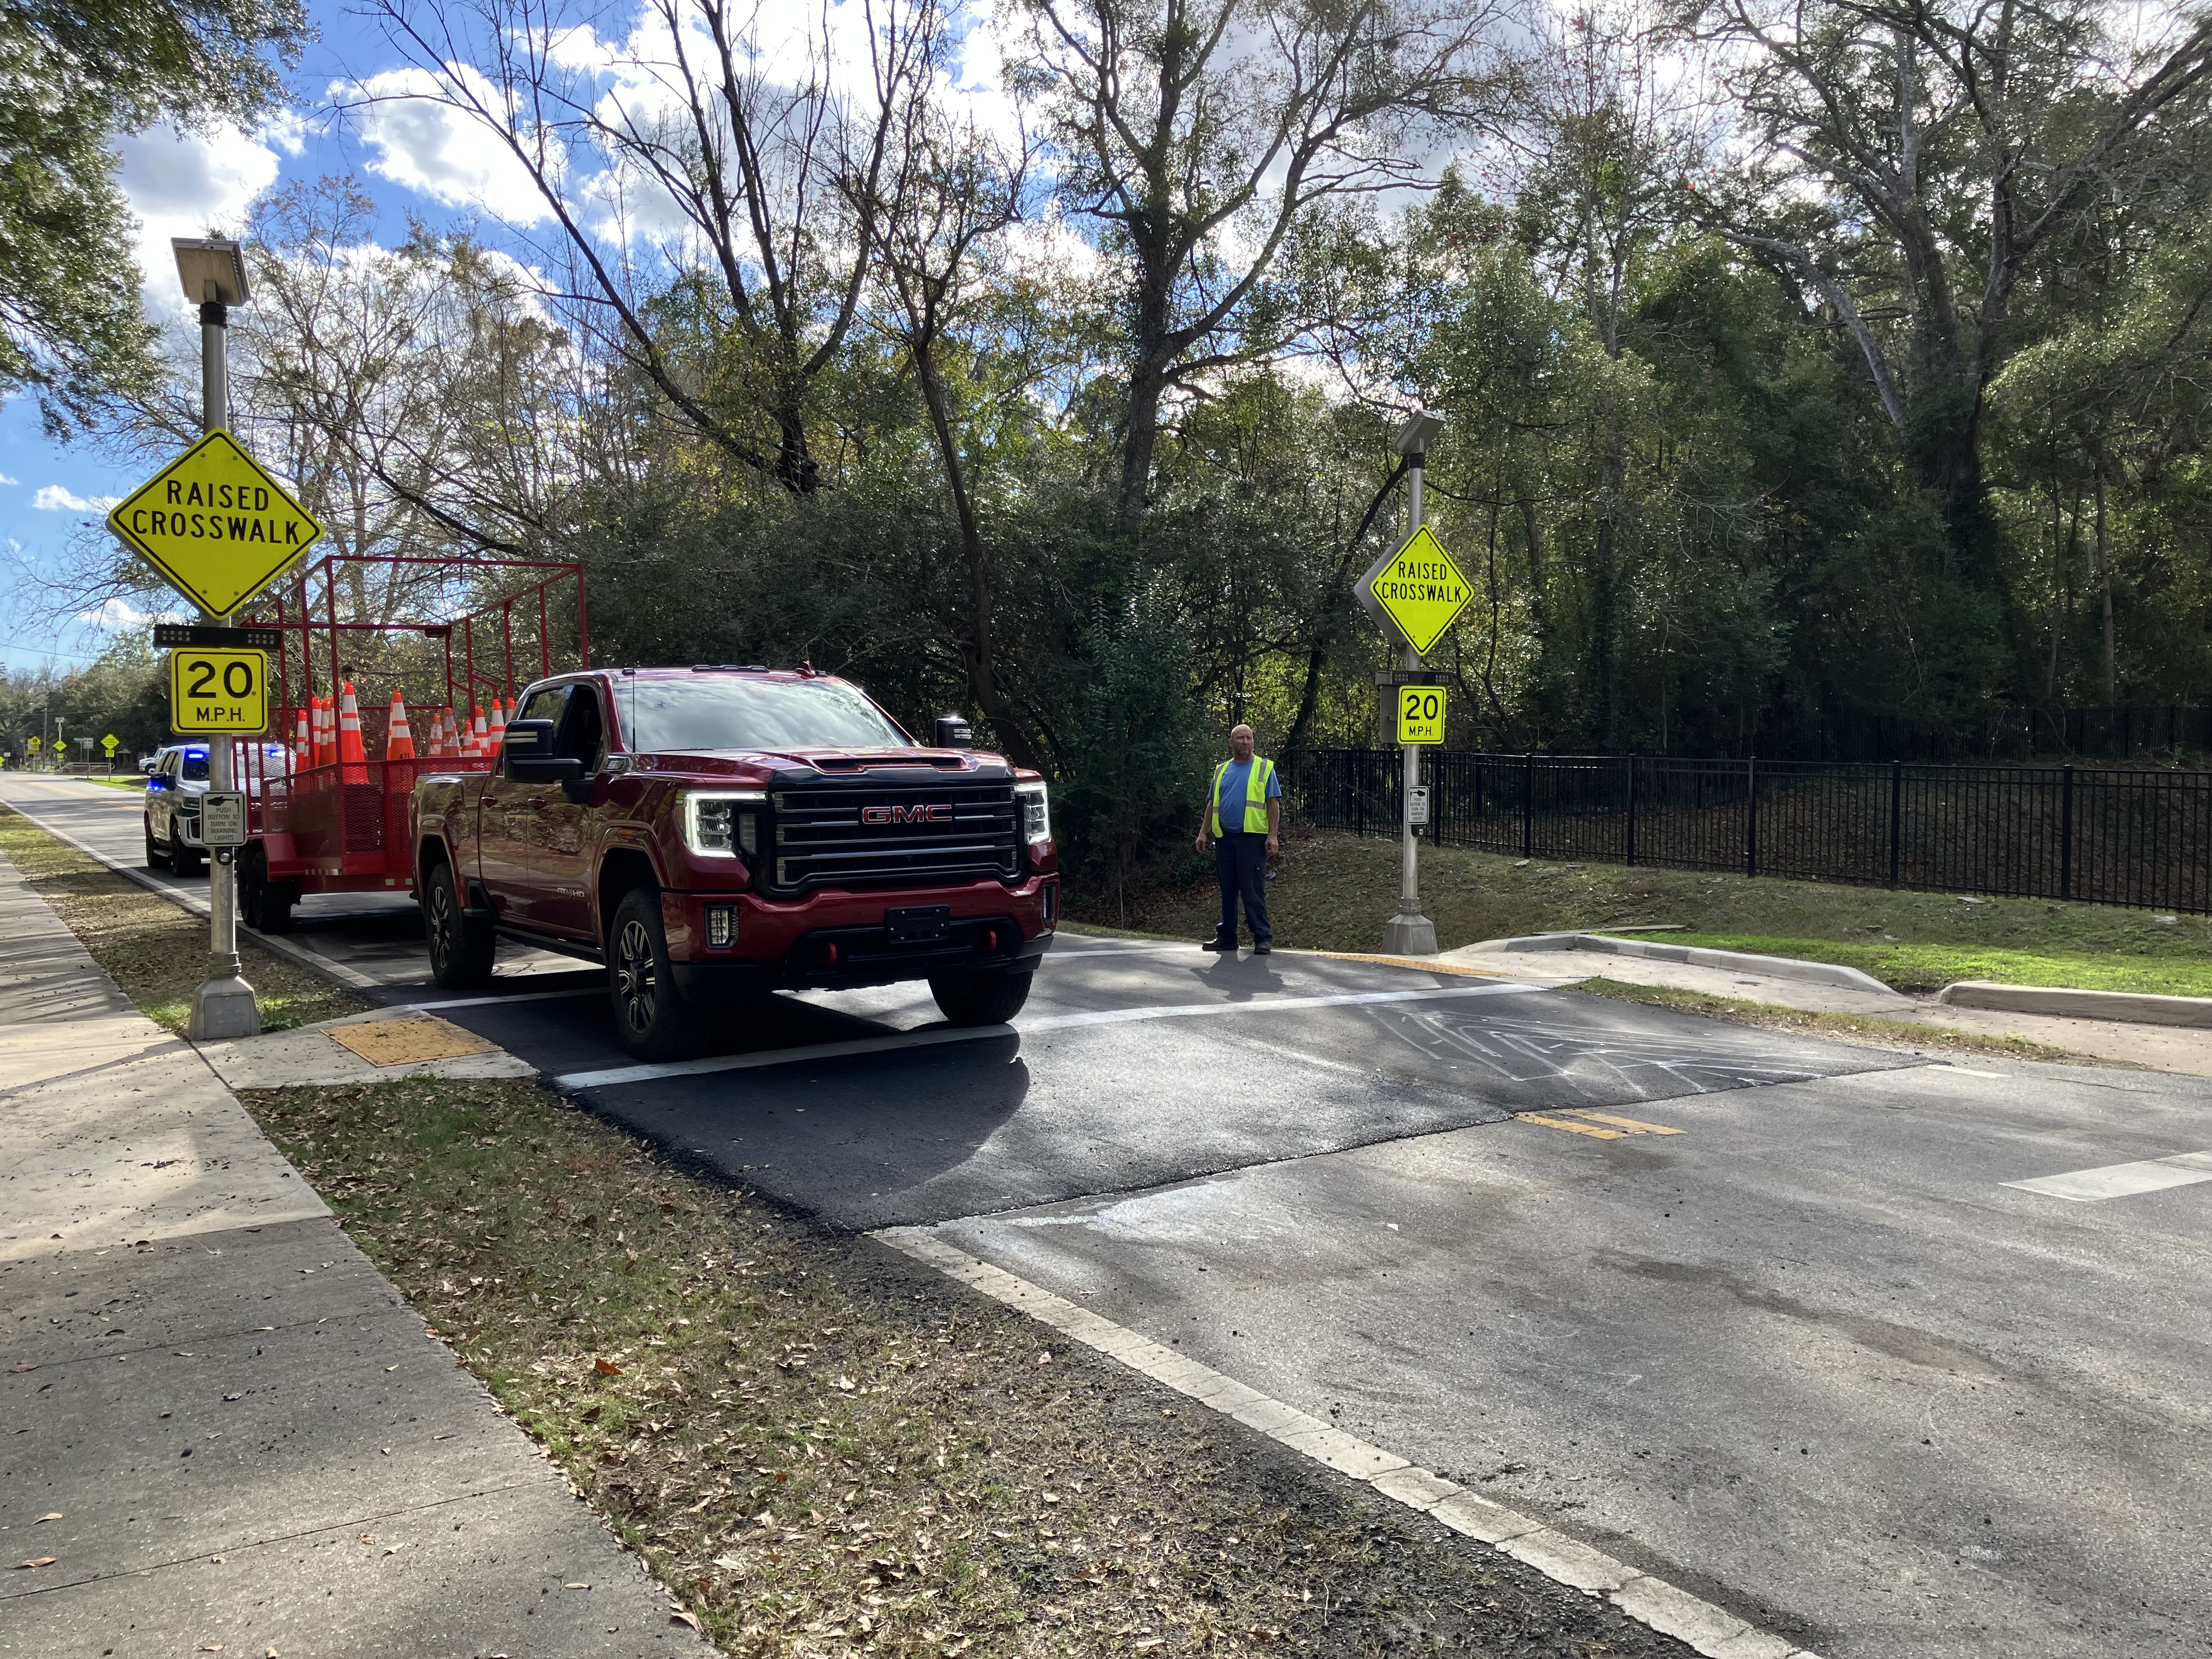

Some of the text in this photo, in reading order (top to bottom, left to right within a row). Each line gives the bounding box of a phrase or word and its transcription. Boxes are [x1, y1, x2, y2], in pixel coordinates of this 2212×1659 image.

[167, 479, 269, 511] RAISED
[132, 509, 300, 545] CROSSWALK
[1398, 561, 1447, 580] RAISED
[1381, 582, 1462, 603] CROSSWALK
[187, 661, 253, 699] 20
[196, 707, 245, 722] M.P.H.
[1405, 695, 1438, 720] 20
[862, 804, 952, 825] GMC
